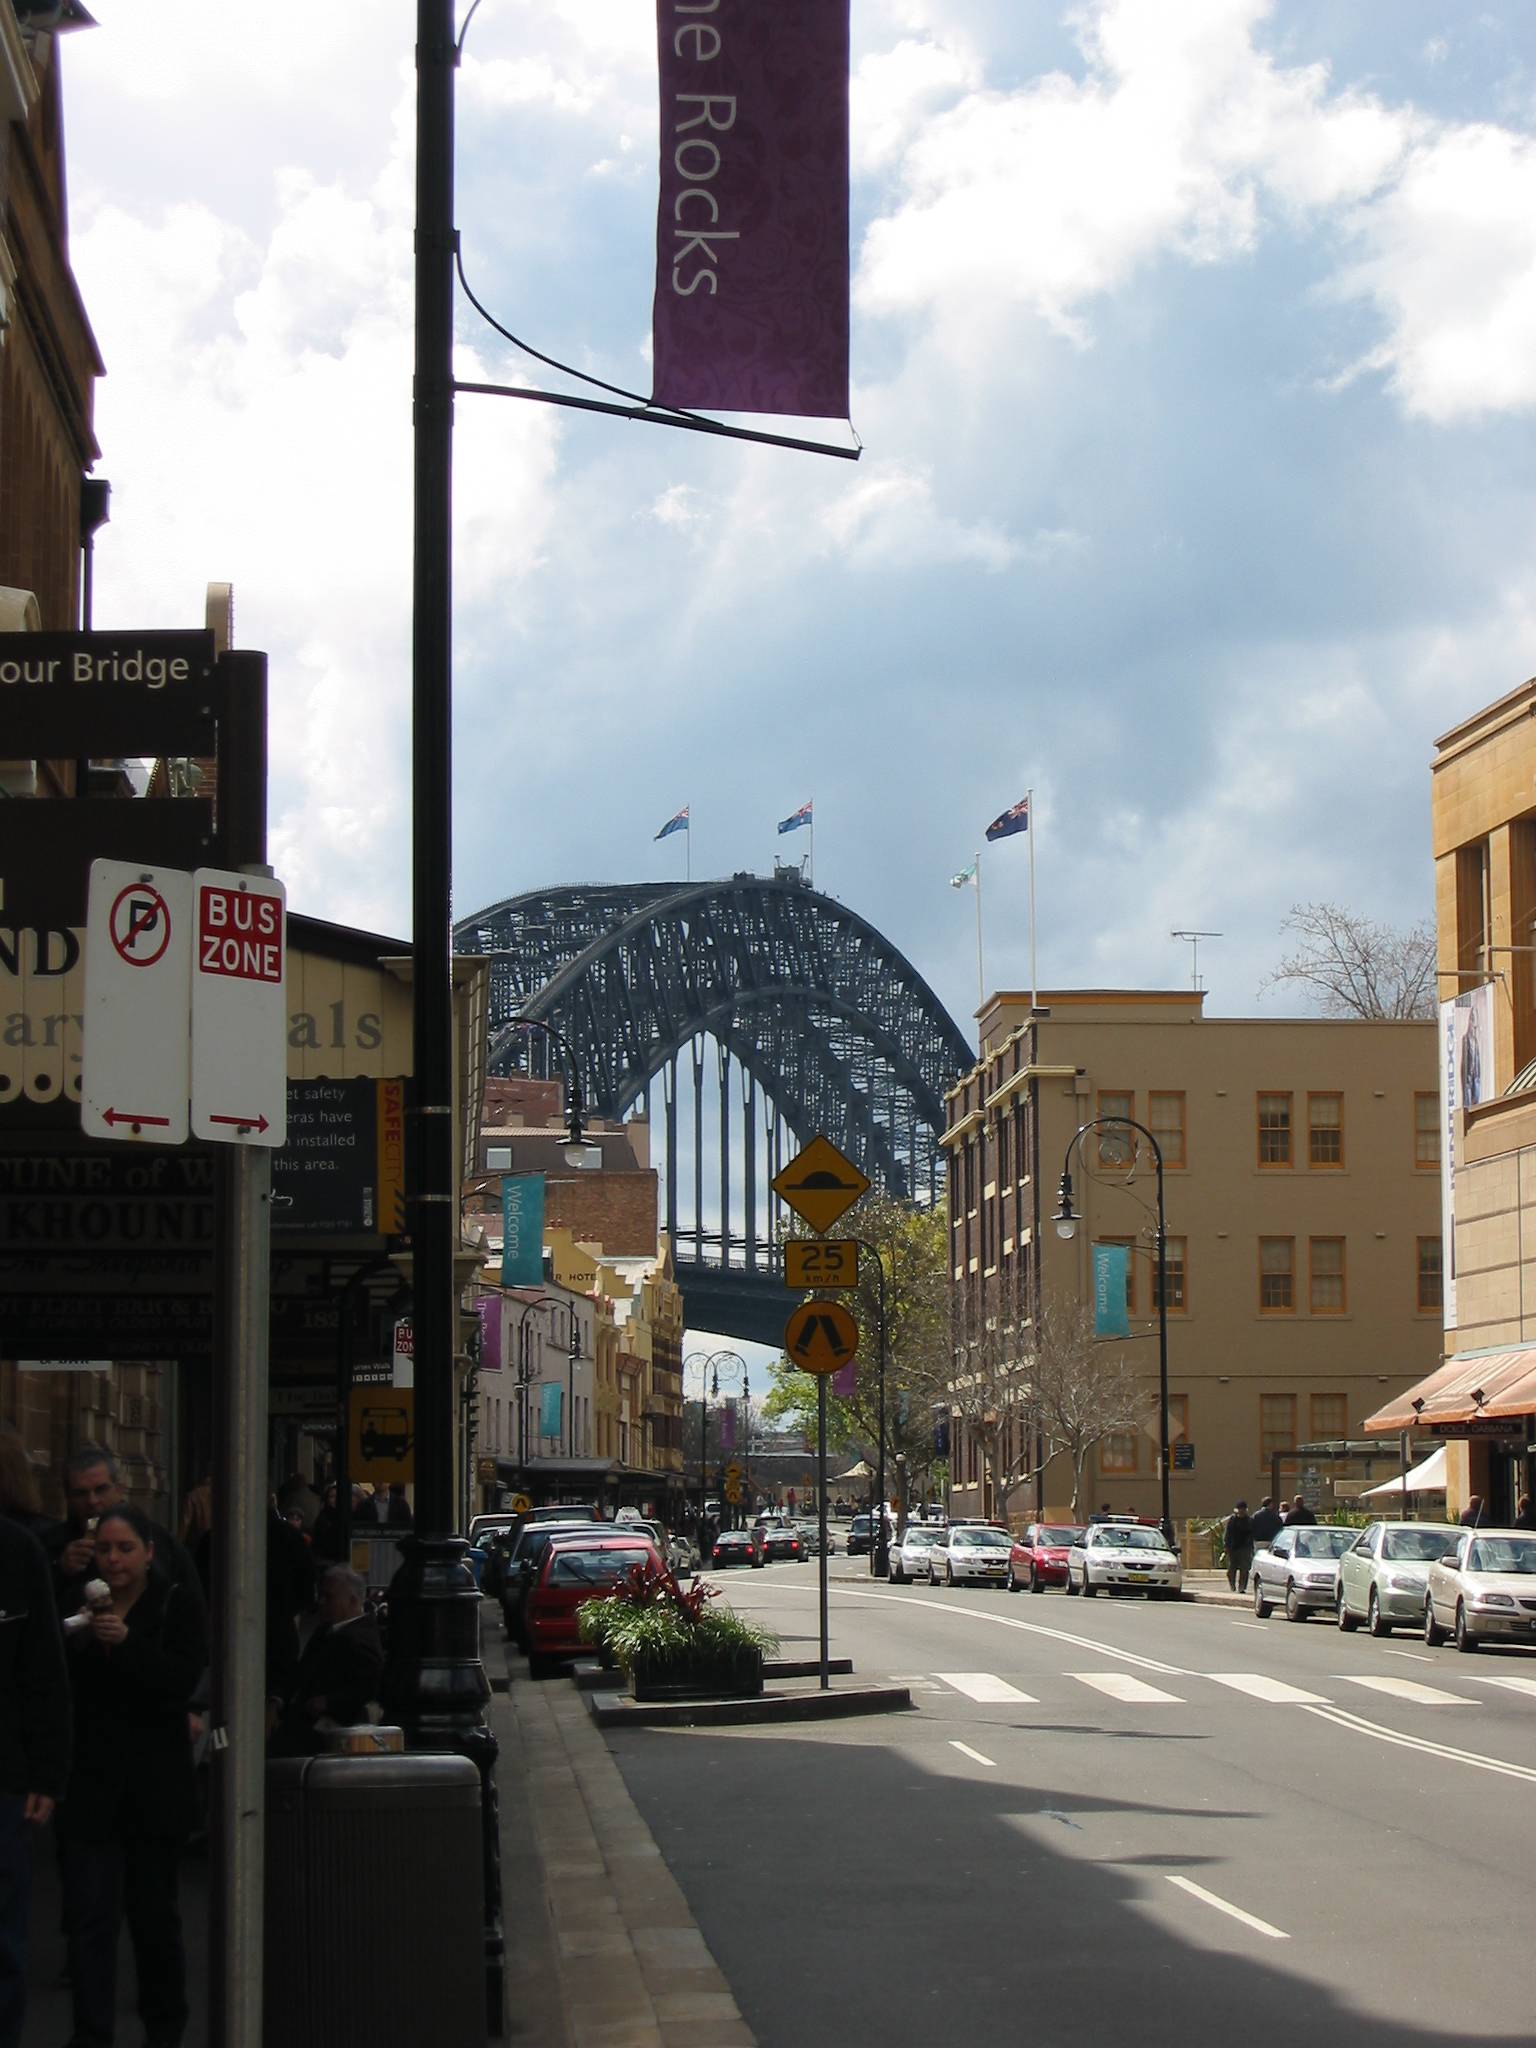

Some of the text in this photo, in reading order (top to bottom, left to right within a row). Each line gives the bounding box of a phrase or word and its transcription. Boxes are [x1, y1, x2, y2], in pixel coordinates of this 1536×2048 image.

[672, 94, 740, 296] Rocks
[0, 650, 189, 688] our Bridge
[129, 899, 158, 949] P
[209, 893, 275, 935] BUS
[202, 935, 280, 978] ZONE
[287, 998, 383, 1050] als
[305, 1086, 345, 1103] safety
[320, 1108, 353, 1123] have
[296, 1132, 356, 1147] installed
[125, 1157, 167, 1188] of
[274, 1157, 340, 1171] this area.
[506, 1185, 523, 1260] Welcome
[801, 1245, 844, 1270] 25
[805, 1274, 840, 1283] km/h
[1097, 1252, 1109, 1315] Welcome
